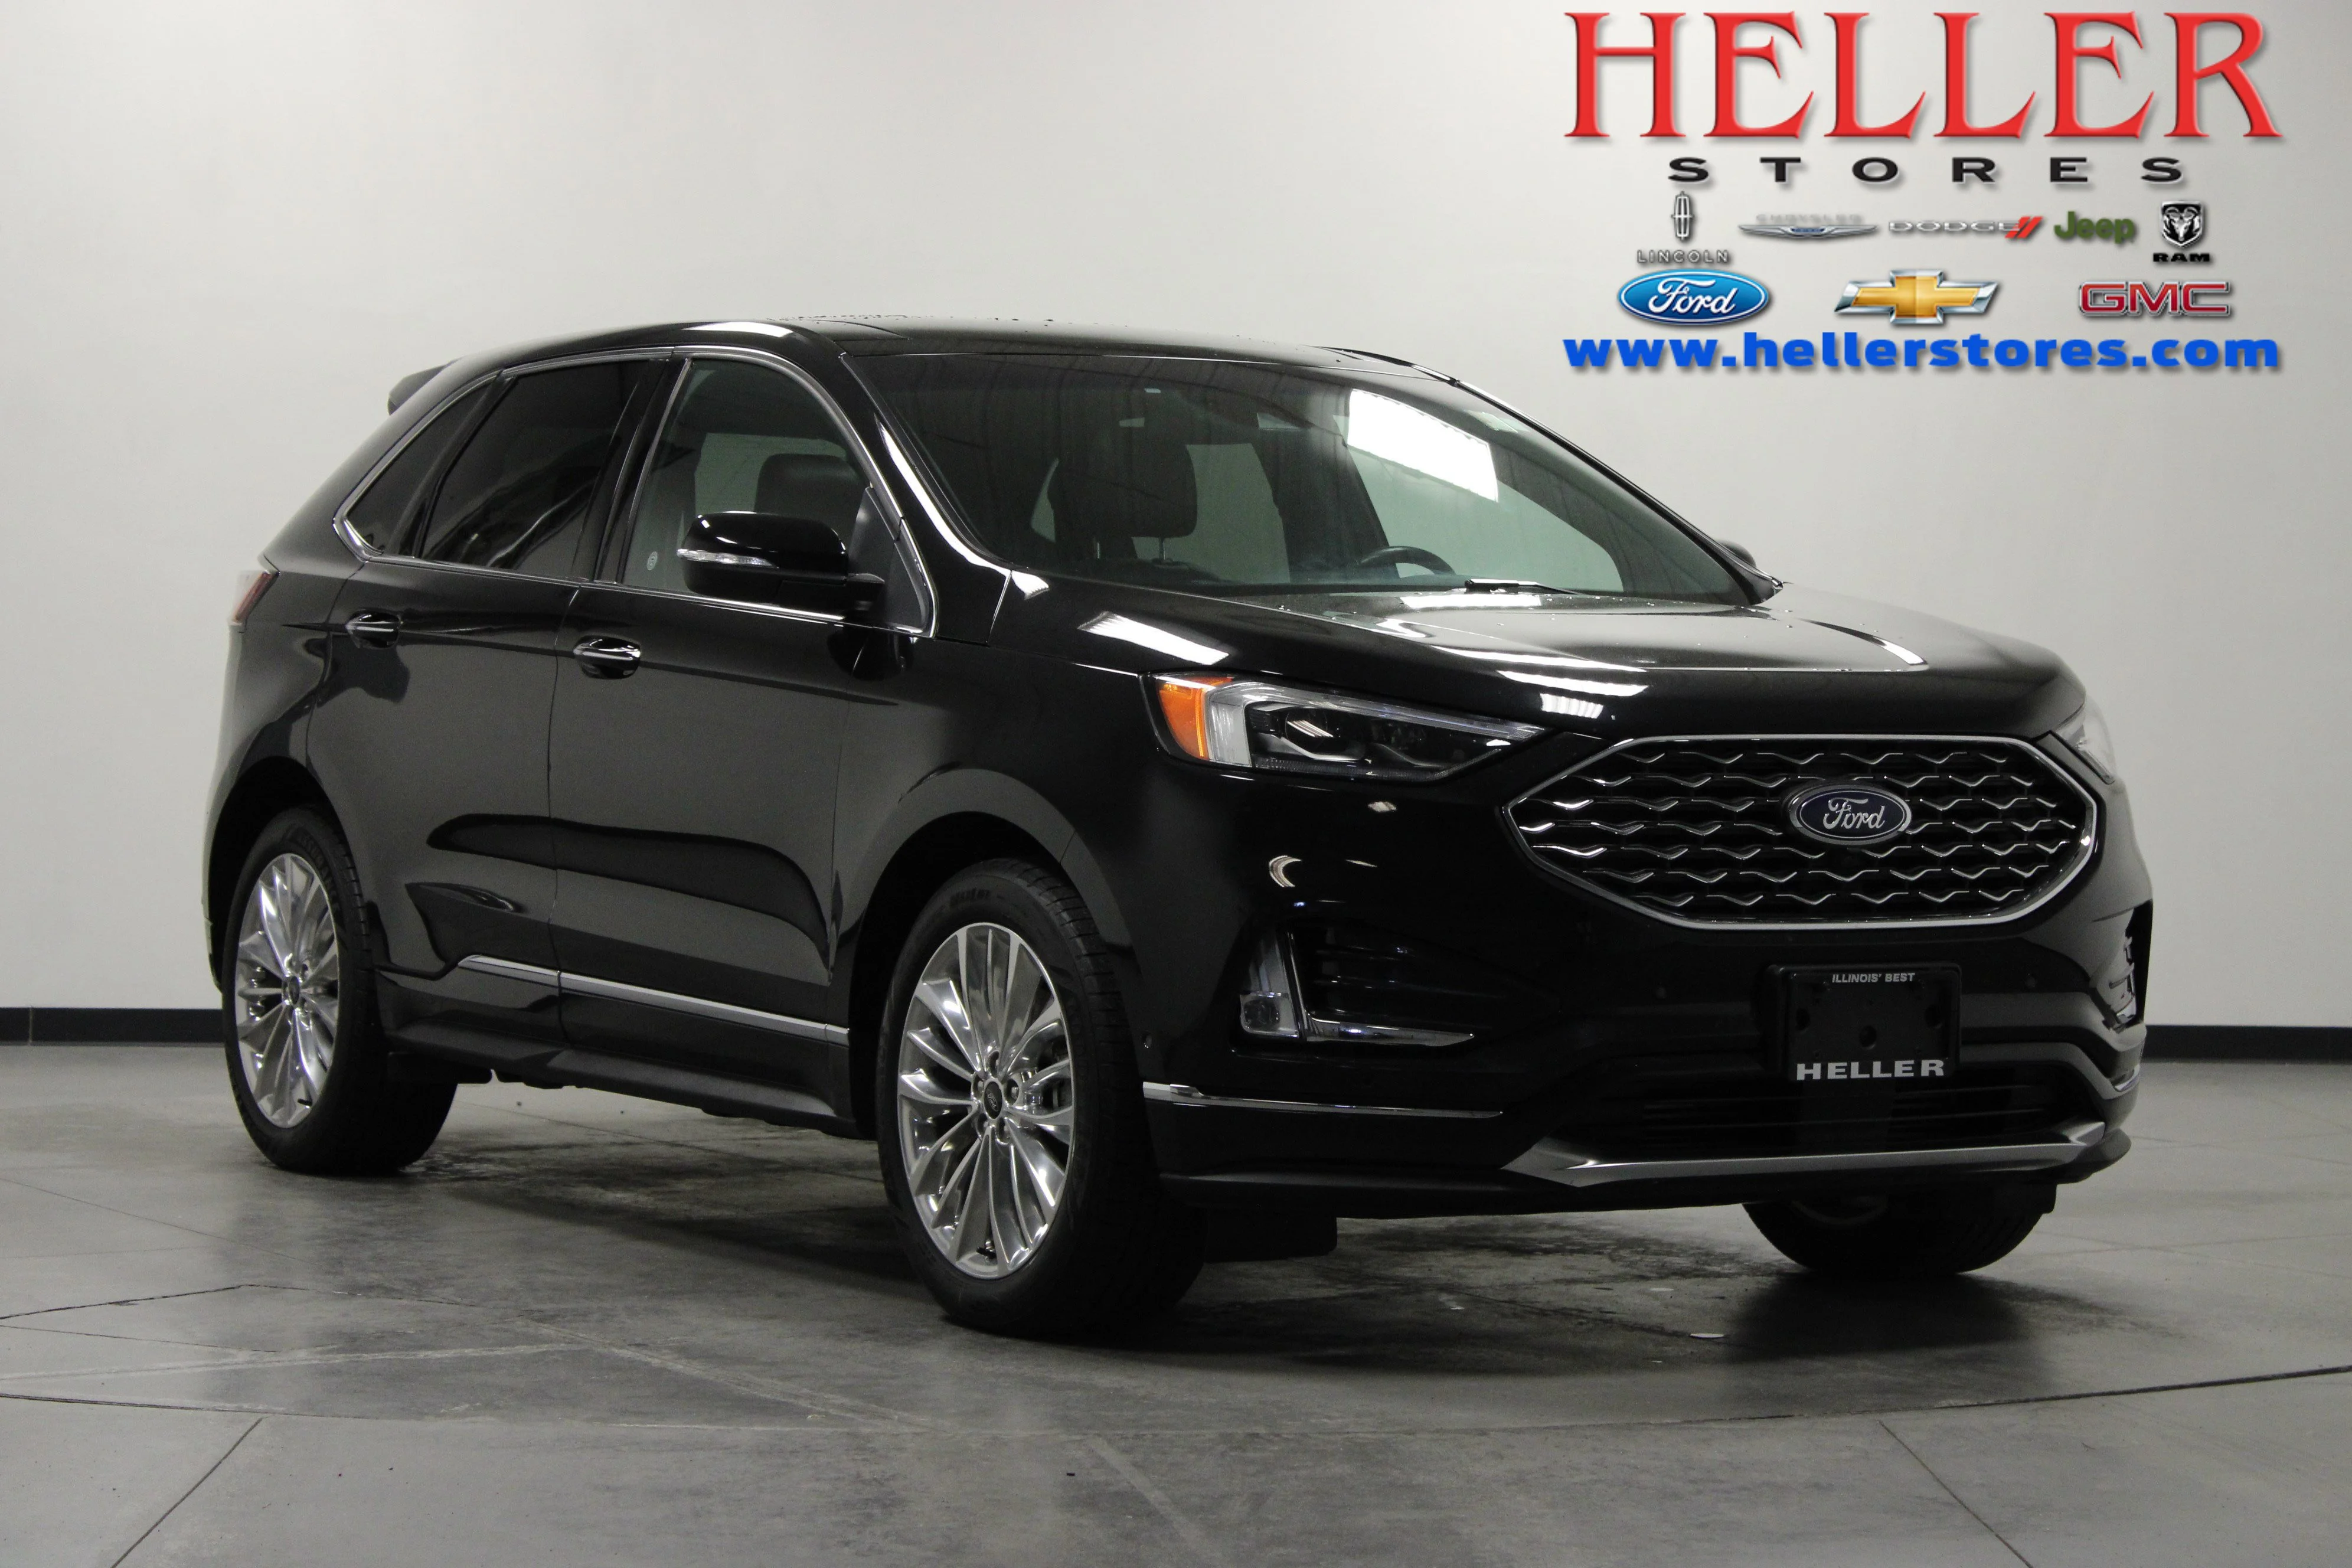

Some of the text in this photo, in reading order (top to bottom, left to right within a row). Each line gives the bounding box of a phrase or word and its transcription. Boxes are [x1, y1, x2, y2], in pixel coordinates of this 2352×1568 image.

[1822, 798, 1885, 829] Ford
[1832, 973, 1916, 984] ILLINOIS' BEST
[1796, 1060, 1945, 1080] HELLER
